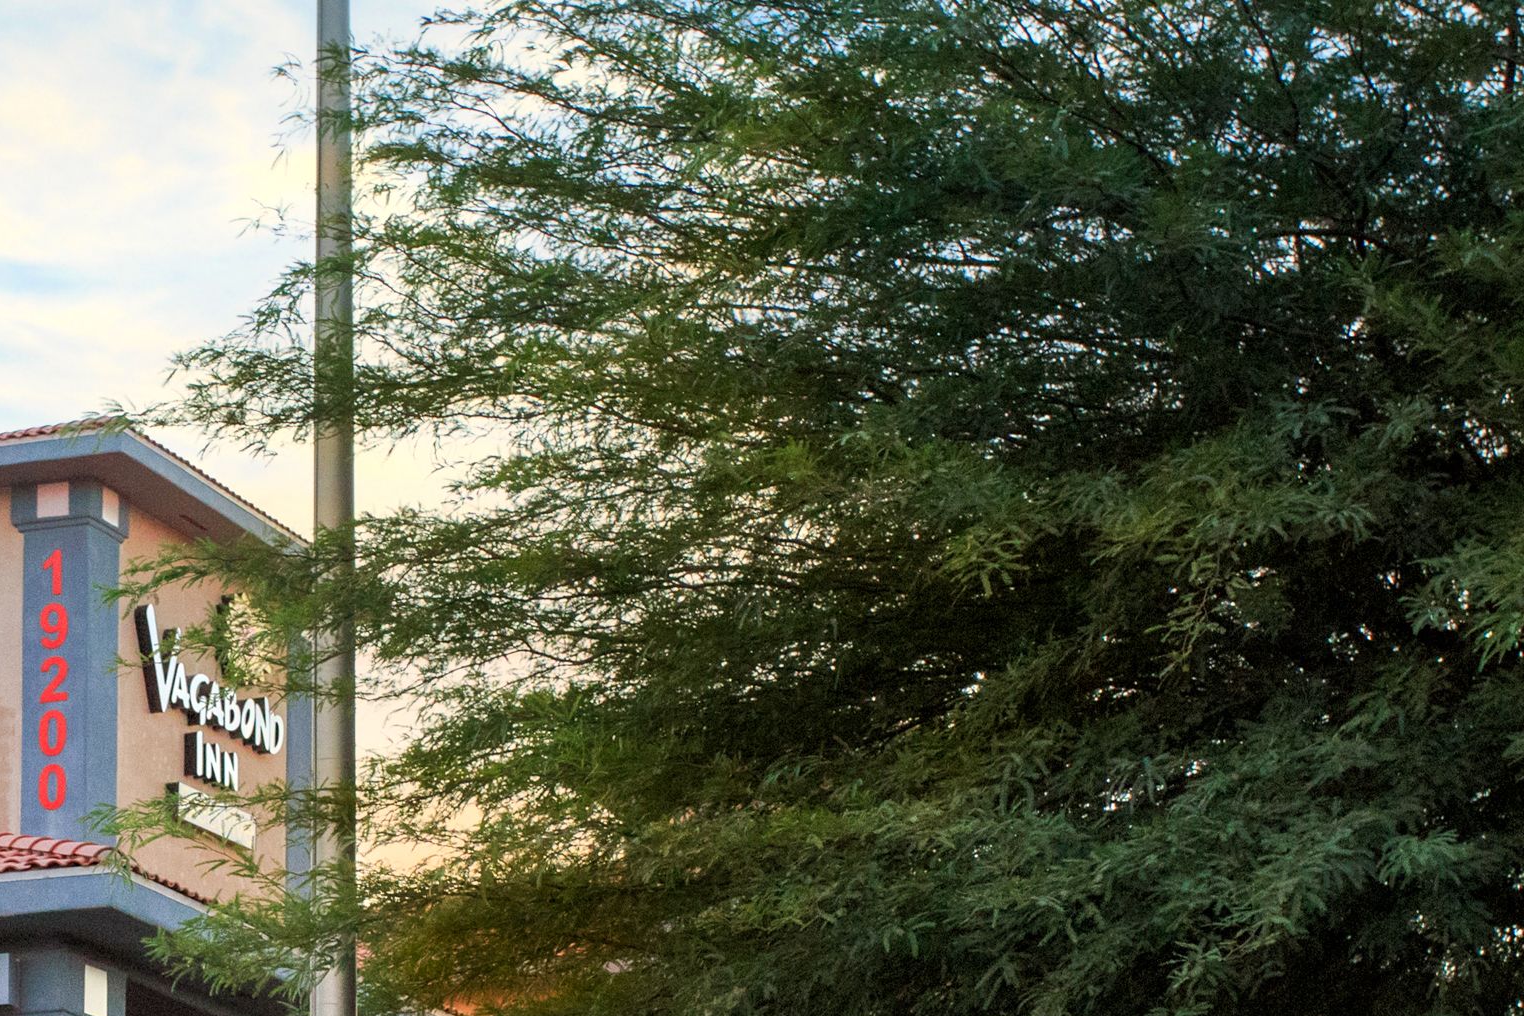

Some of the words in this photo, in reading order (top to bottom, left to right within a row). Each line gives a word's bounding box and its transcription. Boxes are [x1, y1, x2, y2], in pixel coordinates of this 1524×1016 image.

[37, 547, 70, 811] 19200
[143, 603, 284, 755] VAGABOND
[194, 730, 239, 792] INN
